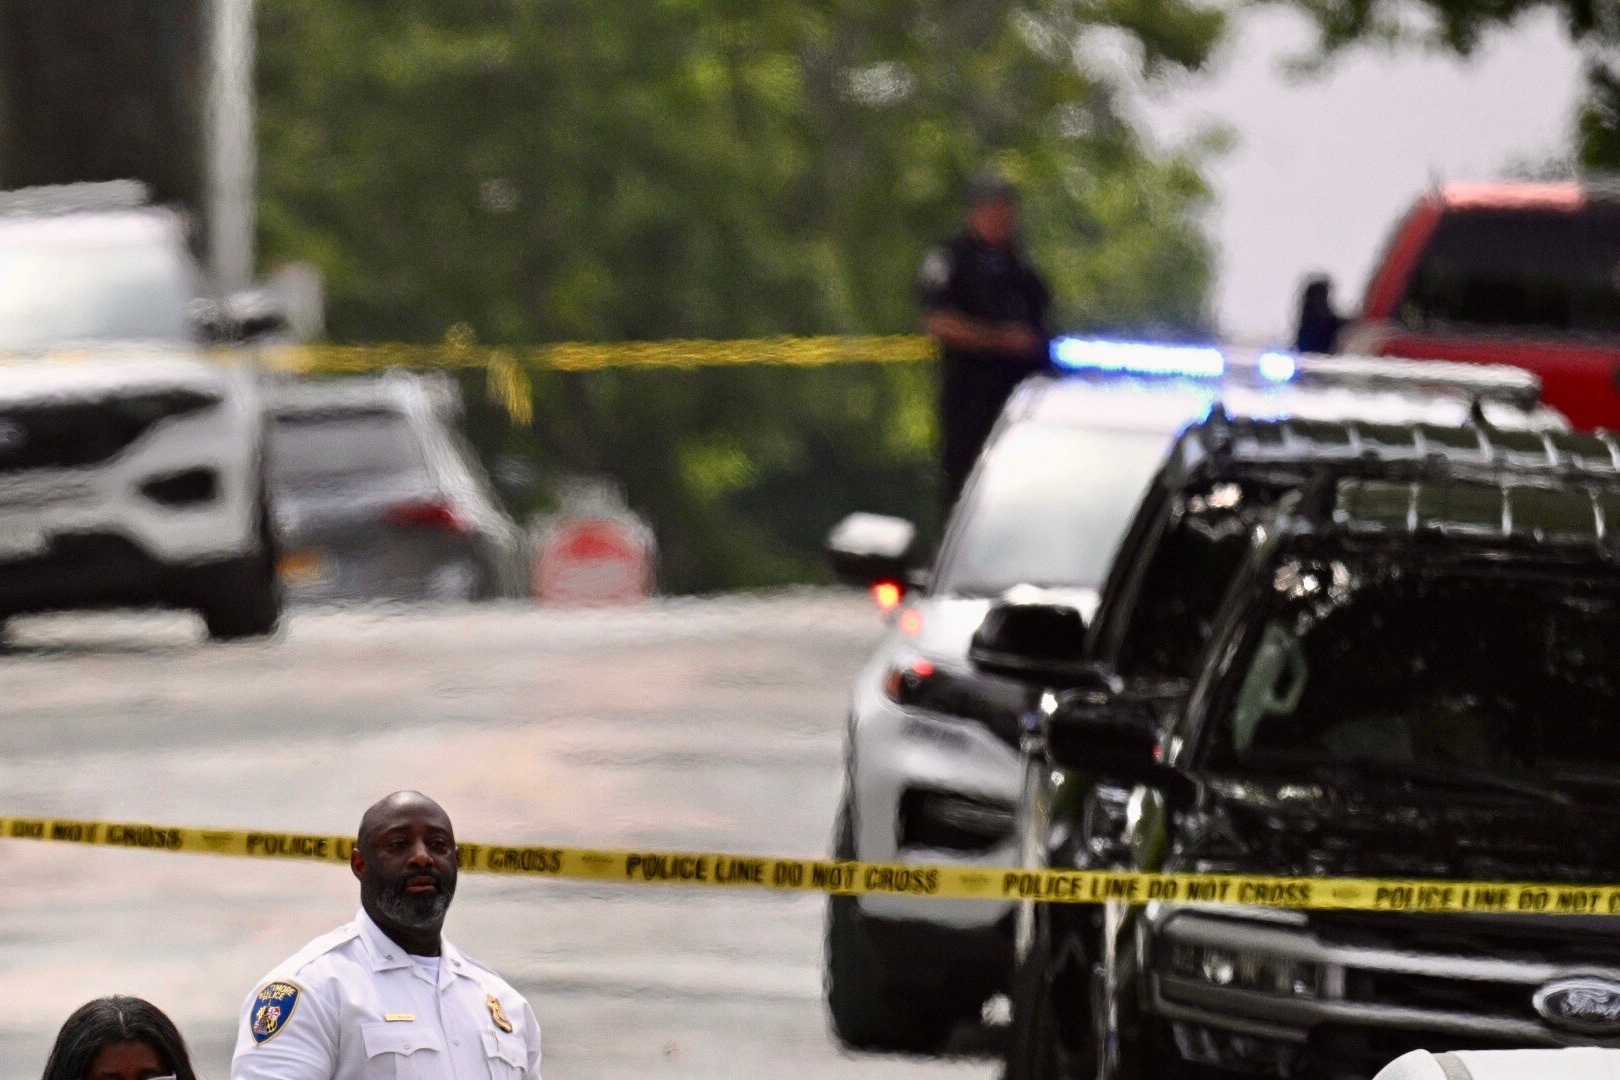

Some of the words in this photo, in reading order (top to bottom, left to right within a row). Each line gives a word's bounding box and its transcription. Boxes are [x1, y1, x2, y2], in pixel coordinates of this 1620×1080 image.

[51, 822, 99, 844] NOT
[105, 825, 182, 850] CROSS
[246, 832, 328, 859] POLICE
[488, 846, 563, 873] CROSS
[626, 853, 708, 881] POLICE
[715, 856, 764, 885] LINE
[773, 860, 804, 888] DO
[812, 862, 859, 890] NOT
[865, 865, 940, 895] CROSS
[1002, 872, 1081, 898] POLICE
[1091, 874, 1138, 899] LINE
[1147, 878, 1178, 900] DO
[1185, 880, 1231, 902] NOT
[1237, 881, 1311, 904] CROSS
[1376, 886, 1455, 909] POLICE
[1462, 887, 1511, 909] LINE
[1518, 889, 1548, 911] DO
[1556, 889, 1601, 911] NOT
